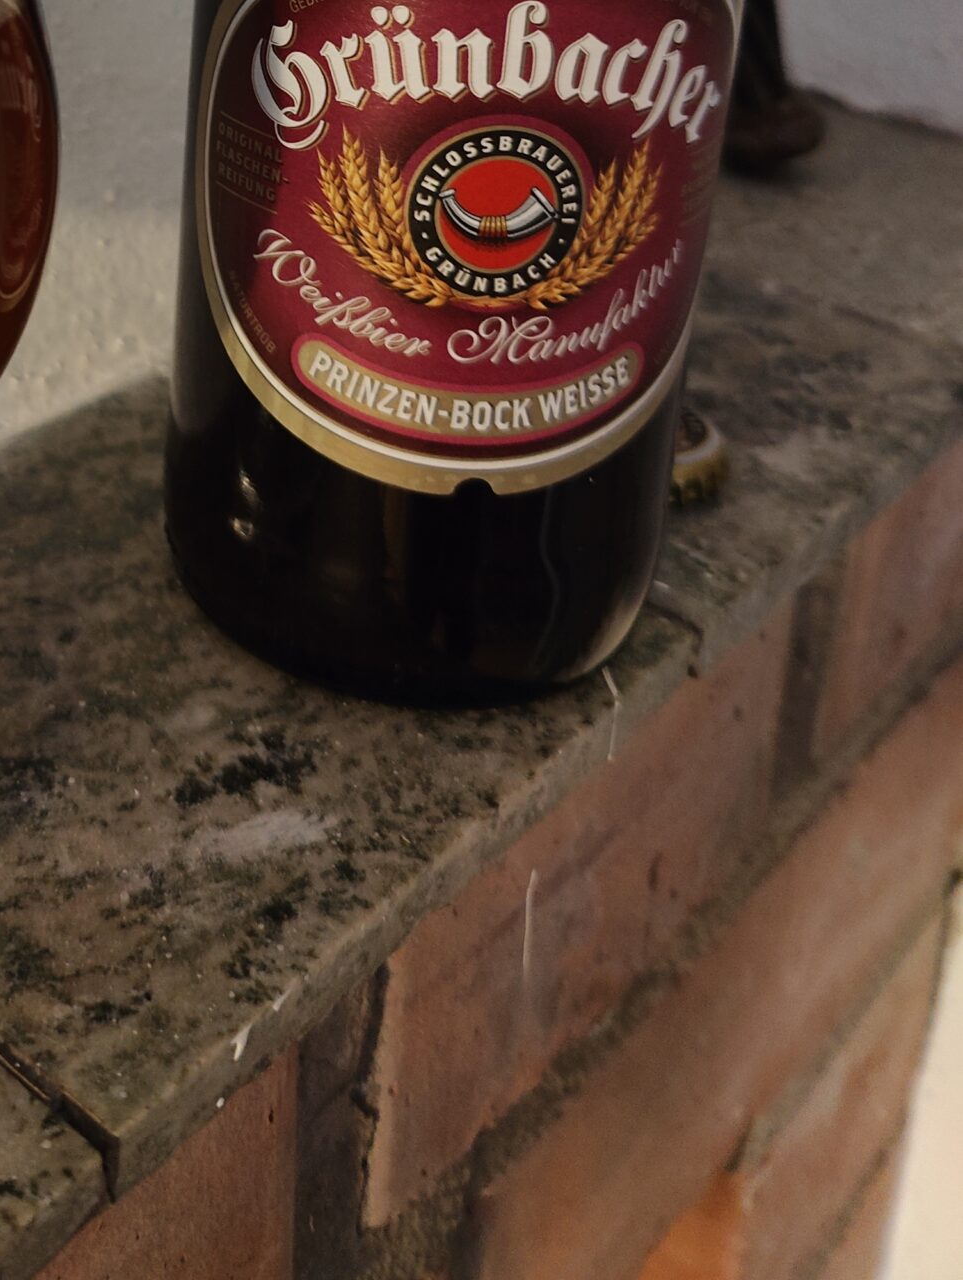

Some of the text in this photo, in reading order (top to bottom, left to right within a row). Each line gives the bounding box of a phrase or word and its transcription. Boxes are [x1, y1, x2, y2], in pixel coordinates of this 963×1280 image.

[252, 0, 722, 149] Grünbacher
[218, 121, 283, 164] ORIGINAL
[218, 161, 276, 202] REIFUNG
[413, 135, 578, 225] SCHLOSSBRAUEREI
[253, 228, 433, 358] Weißbier
[446, 238, 685, 366] Manufaktur
[425, 245, 557, 294] GRÜNBACH
[307, 348, 631, 432] PRINZEN-BOCK WEISSE
